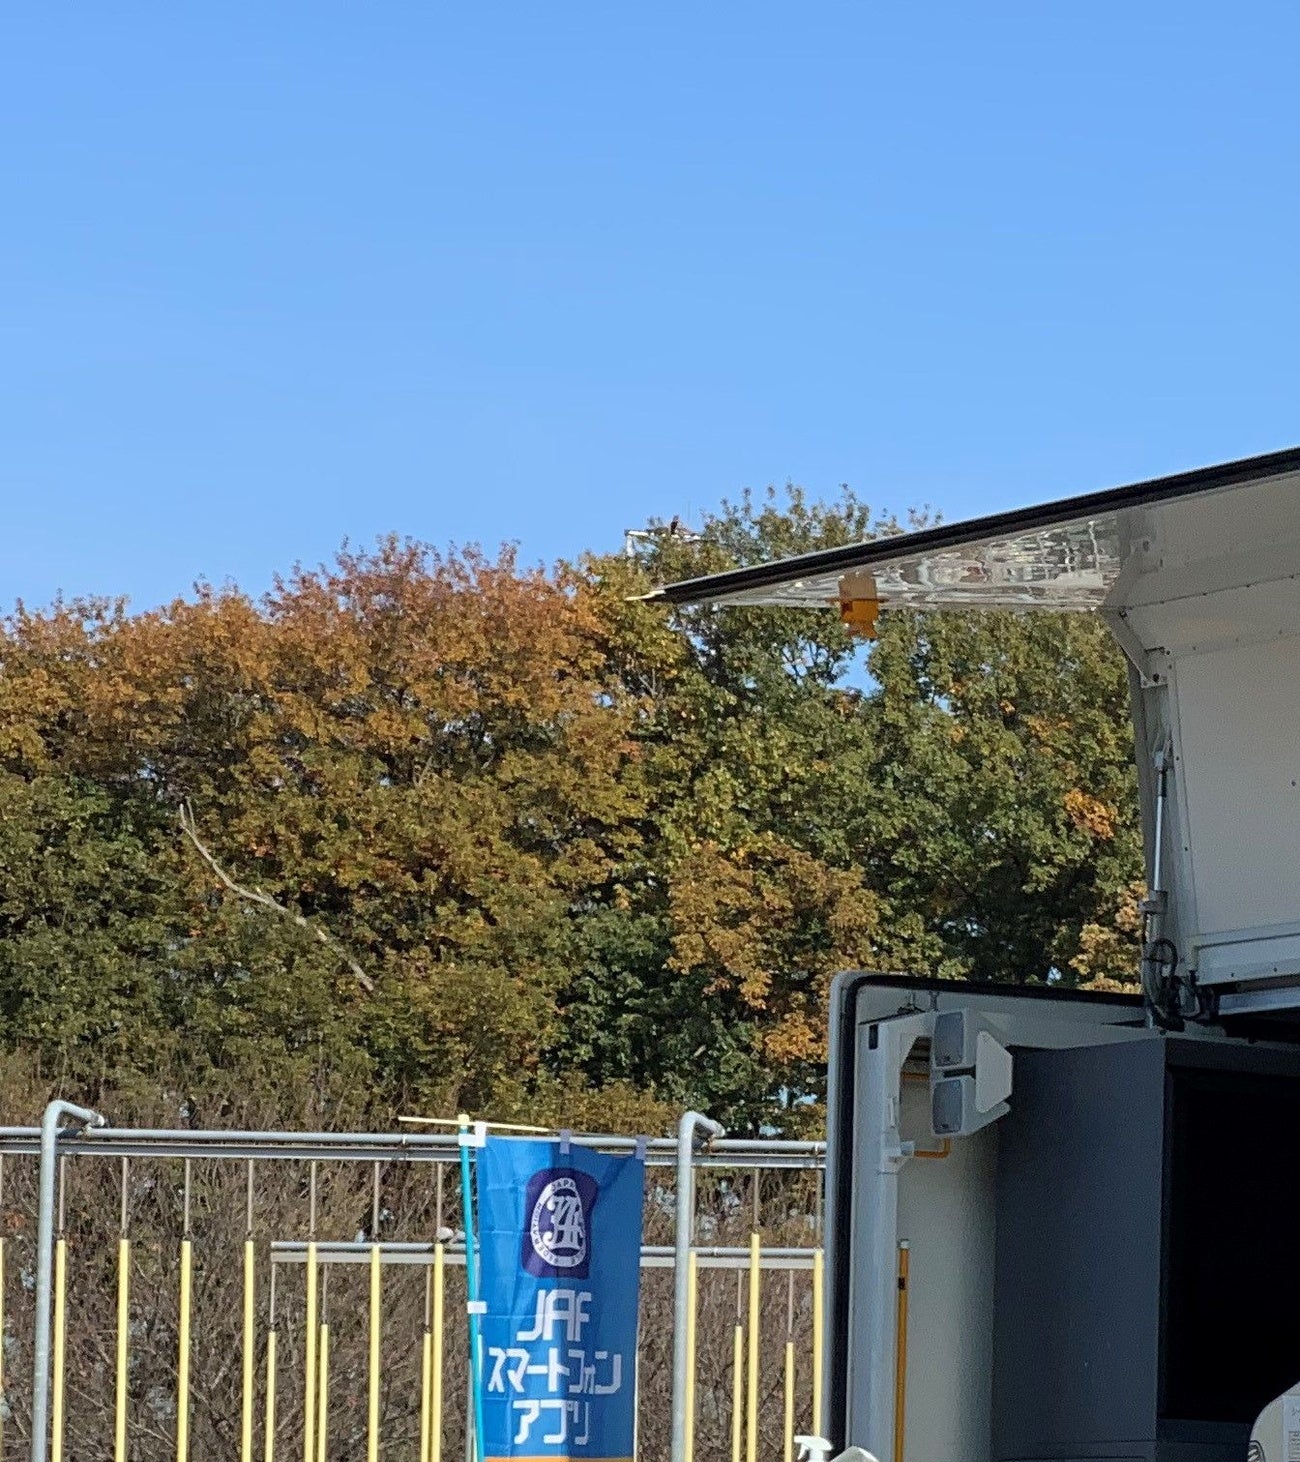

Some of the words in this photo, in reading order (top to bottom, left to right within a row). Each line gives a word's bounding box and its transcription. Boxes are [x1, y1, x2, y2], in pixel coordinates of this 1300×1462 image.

[516, 1289, 592, 1342] JAF
[487, 1347, 622, 1395] スマートフォン
[512, 1399, 590, 1446] アプリ
